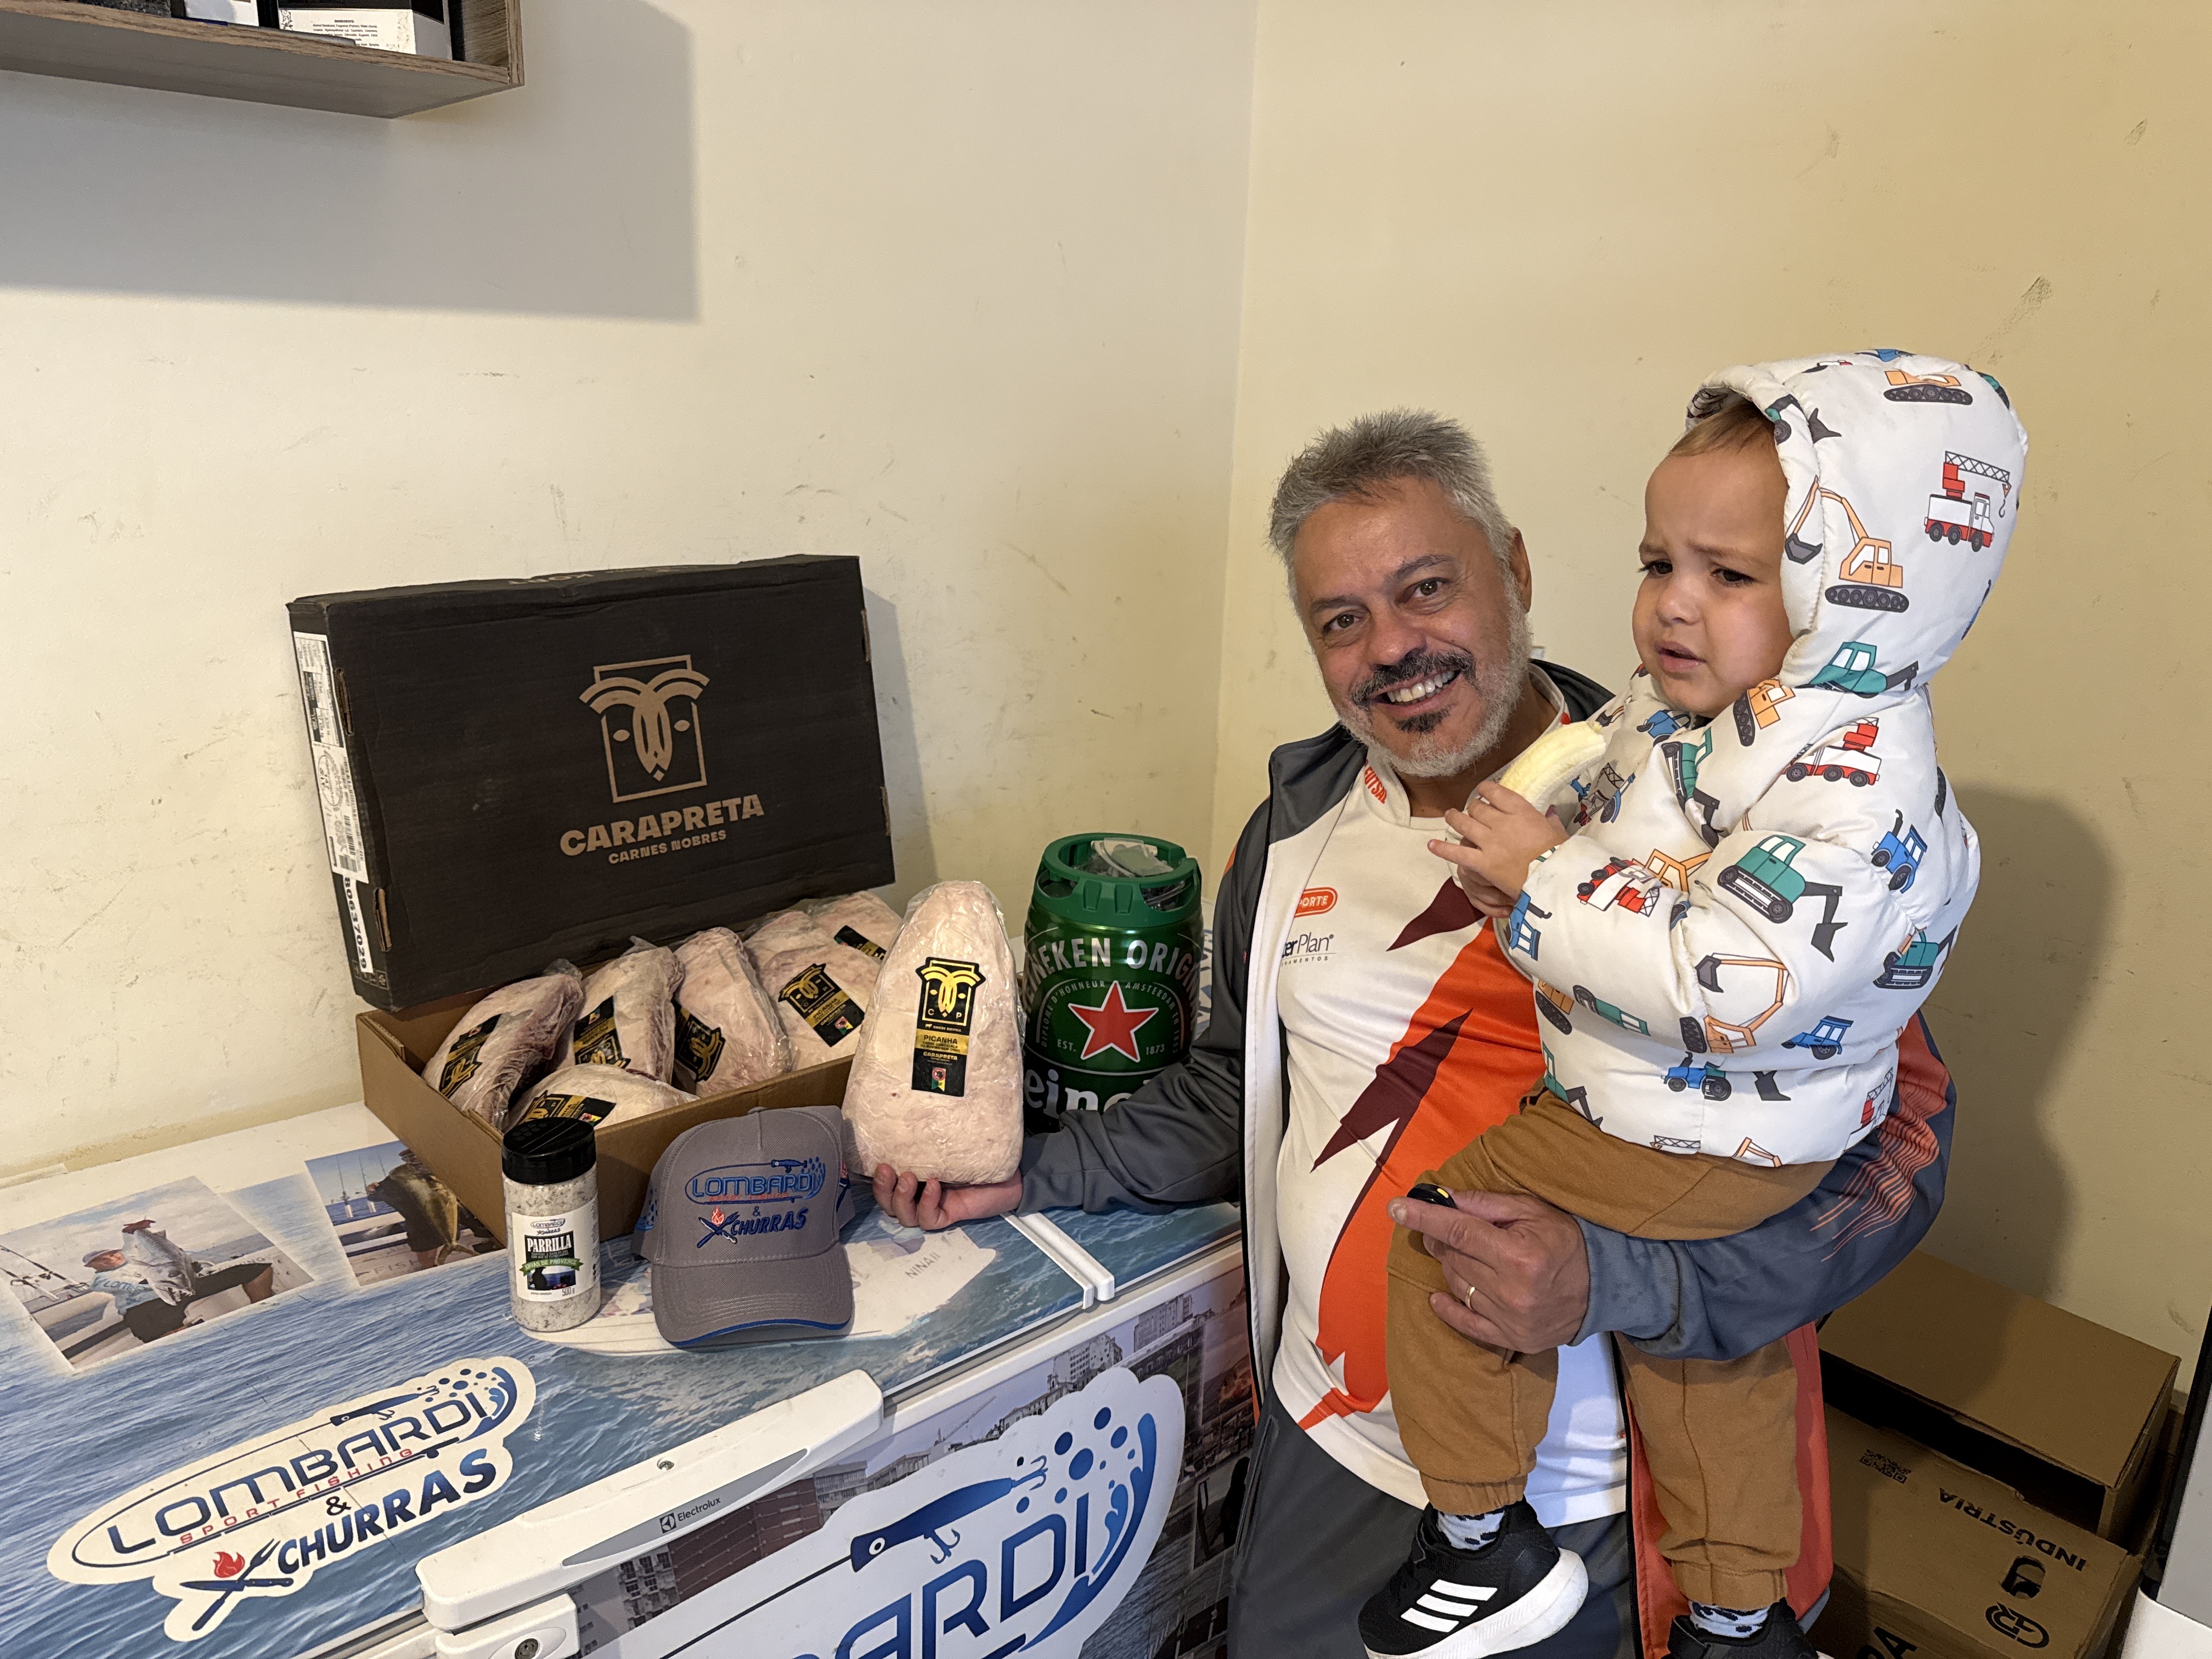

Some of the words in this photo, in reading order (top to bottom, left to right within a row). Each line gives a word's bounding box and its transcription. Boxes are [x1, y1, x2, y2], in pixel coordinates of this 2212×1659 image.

[560, 794, 764, 856] CARAPRETA
[608, 843, 668, 865] CARNES
[671, 830, 727, 851] NOBRES
[1051, 980, 1105, 1003] D'HONNEUR
[1125, 981, 1176, 1010] AMSTERDAM
[924, 1035, 957, 1044] PICANHA
[1057, 1039, 1076, 1052] EST.
[1146, 1044, 1165, 1056] 1873
[923, 1051, 958, 1060] CARAPRETA
[692, 1173, 815, 1197] LOMBARDI
[731, 1207, 809, 1235] CHURRAS
[753, 1206, 761, 1217] &
[527, 1234, 572, 1252] PARRILLA
[525, 1261, 540, 1271] ERVAS
[562, 1288, 572, 1297] 500
[108, 1392, 487, 1554] LOMBARDI
[180, 1498, 280, 1544] SPORT
[296, 1448, 413, 1499] FISHING
[325, 1496, 352, 1516] &
[278, 1448, 496, 1575] CHURRAS
[678, 1497, 721, 1521] Electrolux
[1939, 1487, 2086, 1572] INDÚSTRIA
